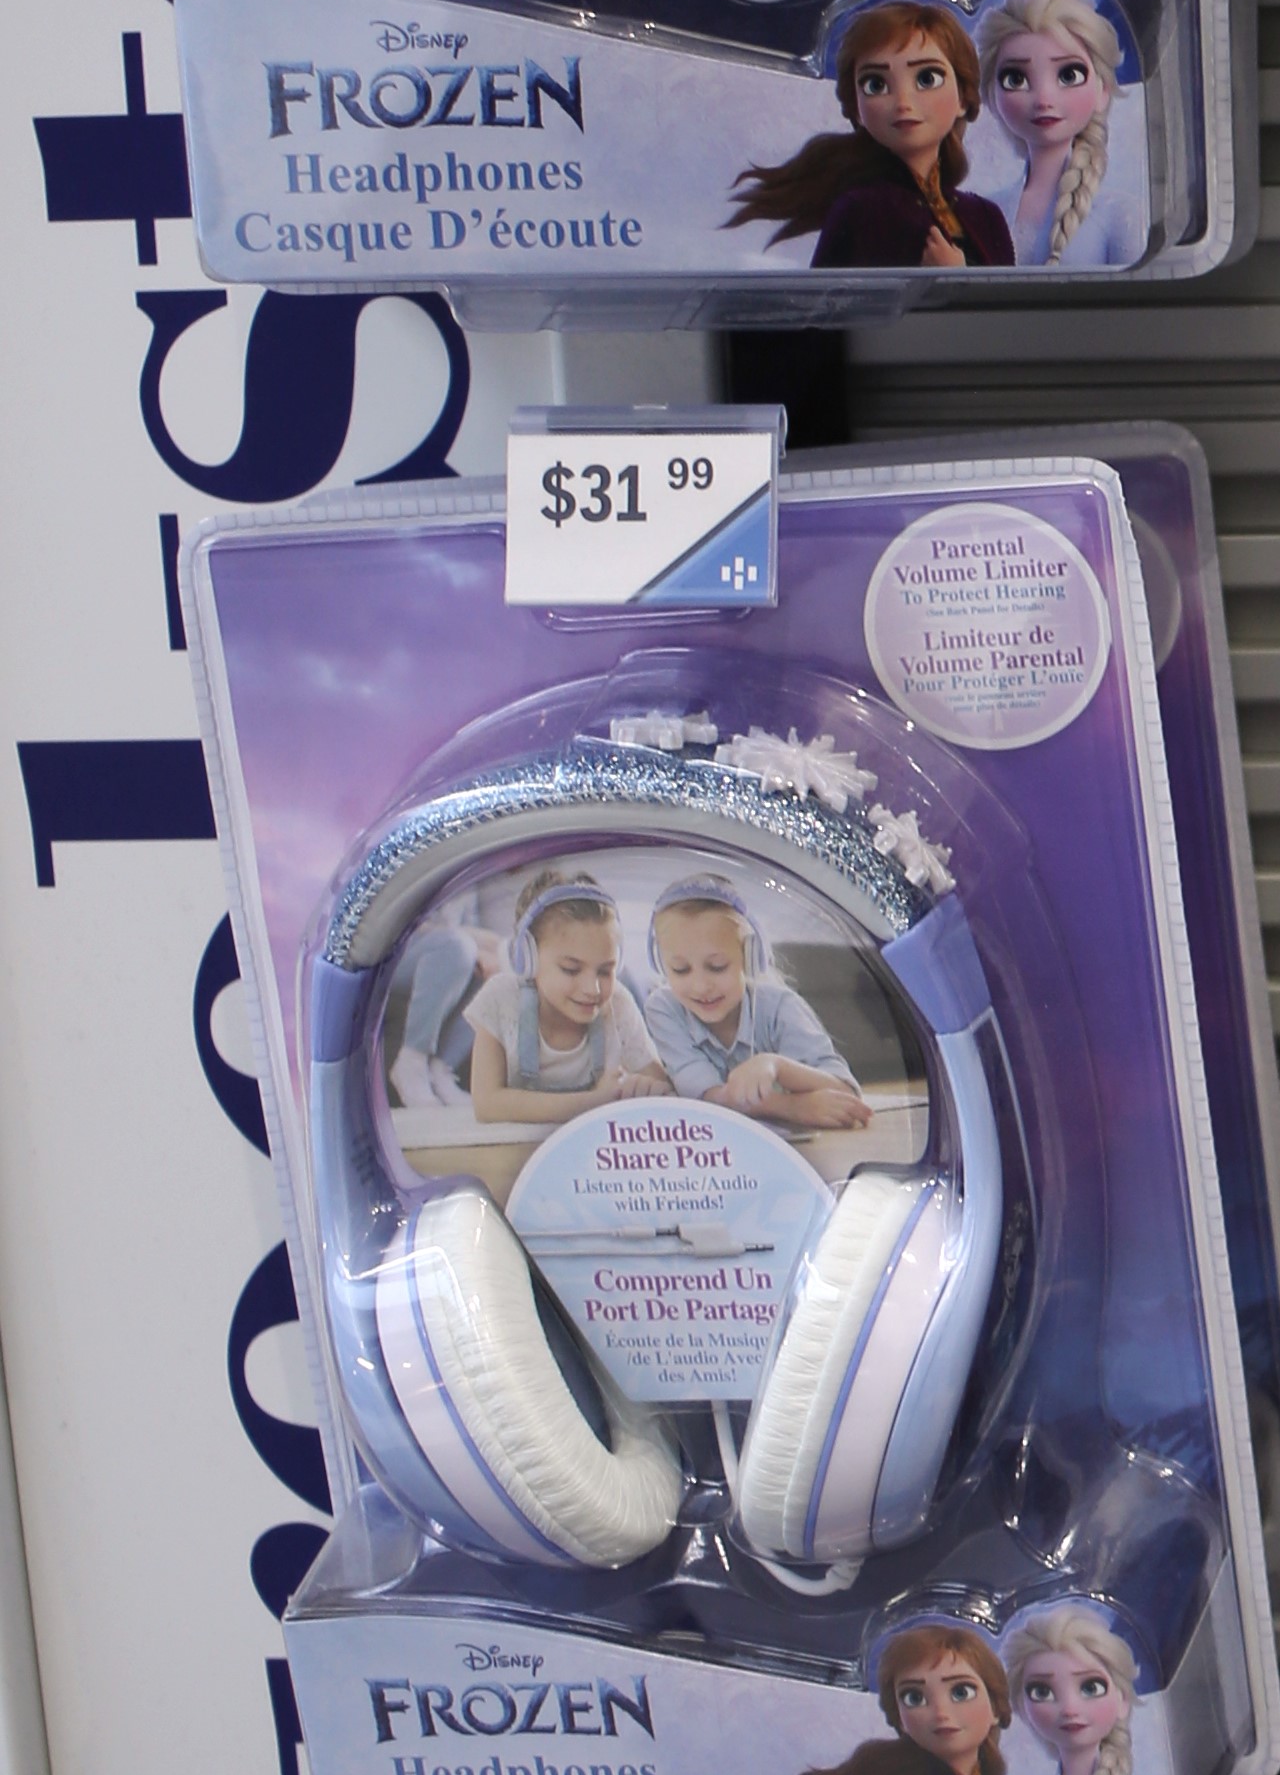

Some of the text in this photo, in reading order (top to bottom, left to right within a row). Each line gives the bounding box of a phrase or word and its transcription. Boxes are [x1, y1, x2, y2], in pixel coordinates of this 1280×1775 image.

[370, 20, 468, 58] Disney
[262, 55, 584, 138] FROZEN
[284, 152, 583, 204] Headphones
[235, 209, 643, 262] Casque D'écoute
[541, 457, 714, 528] $31 99
[607, 1120, 713, 1144] Includes
[596, 1146, 732, 1171] Share Port
[456, 1643, 544, 1677] Disney
[364, 1674, 656, 1744] FROZEN
